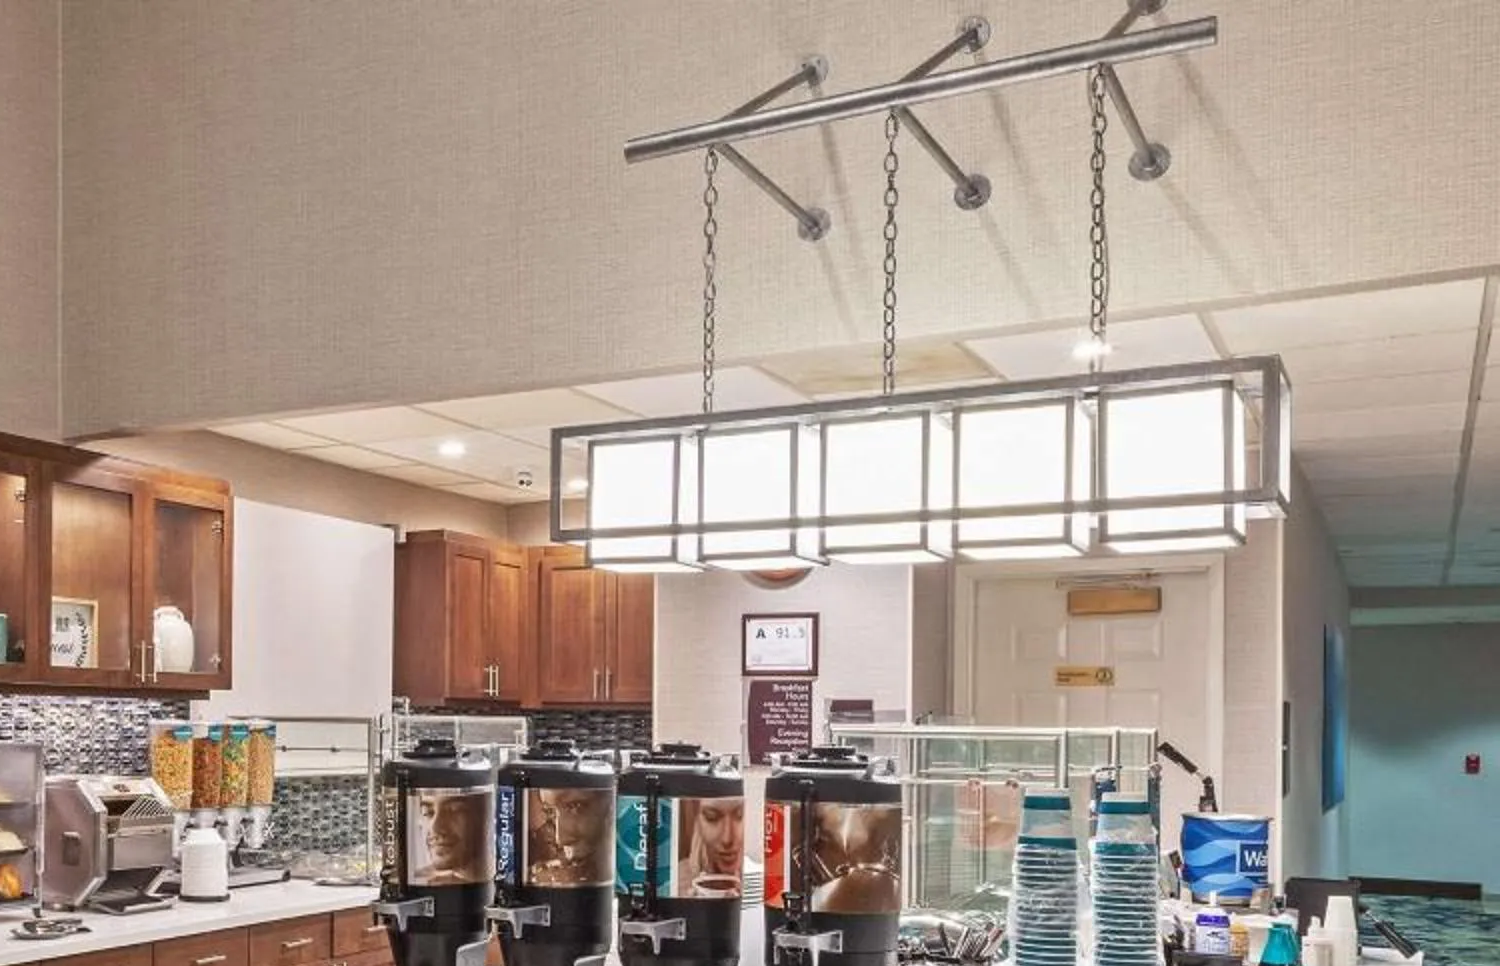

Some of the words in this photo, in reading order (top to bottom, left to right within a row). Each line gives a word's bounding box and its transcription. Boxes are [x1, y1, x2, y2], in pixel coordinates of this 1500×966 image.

[755, 627, 767, 639] A
[772, 683, 809, 693] Breakfast
[785, 692, 809, 701] Hours
[777, 728, 809, 739] Evening
[498, 792, 513, 871] Regular
